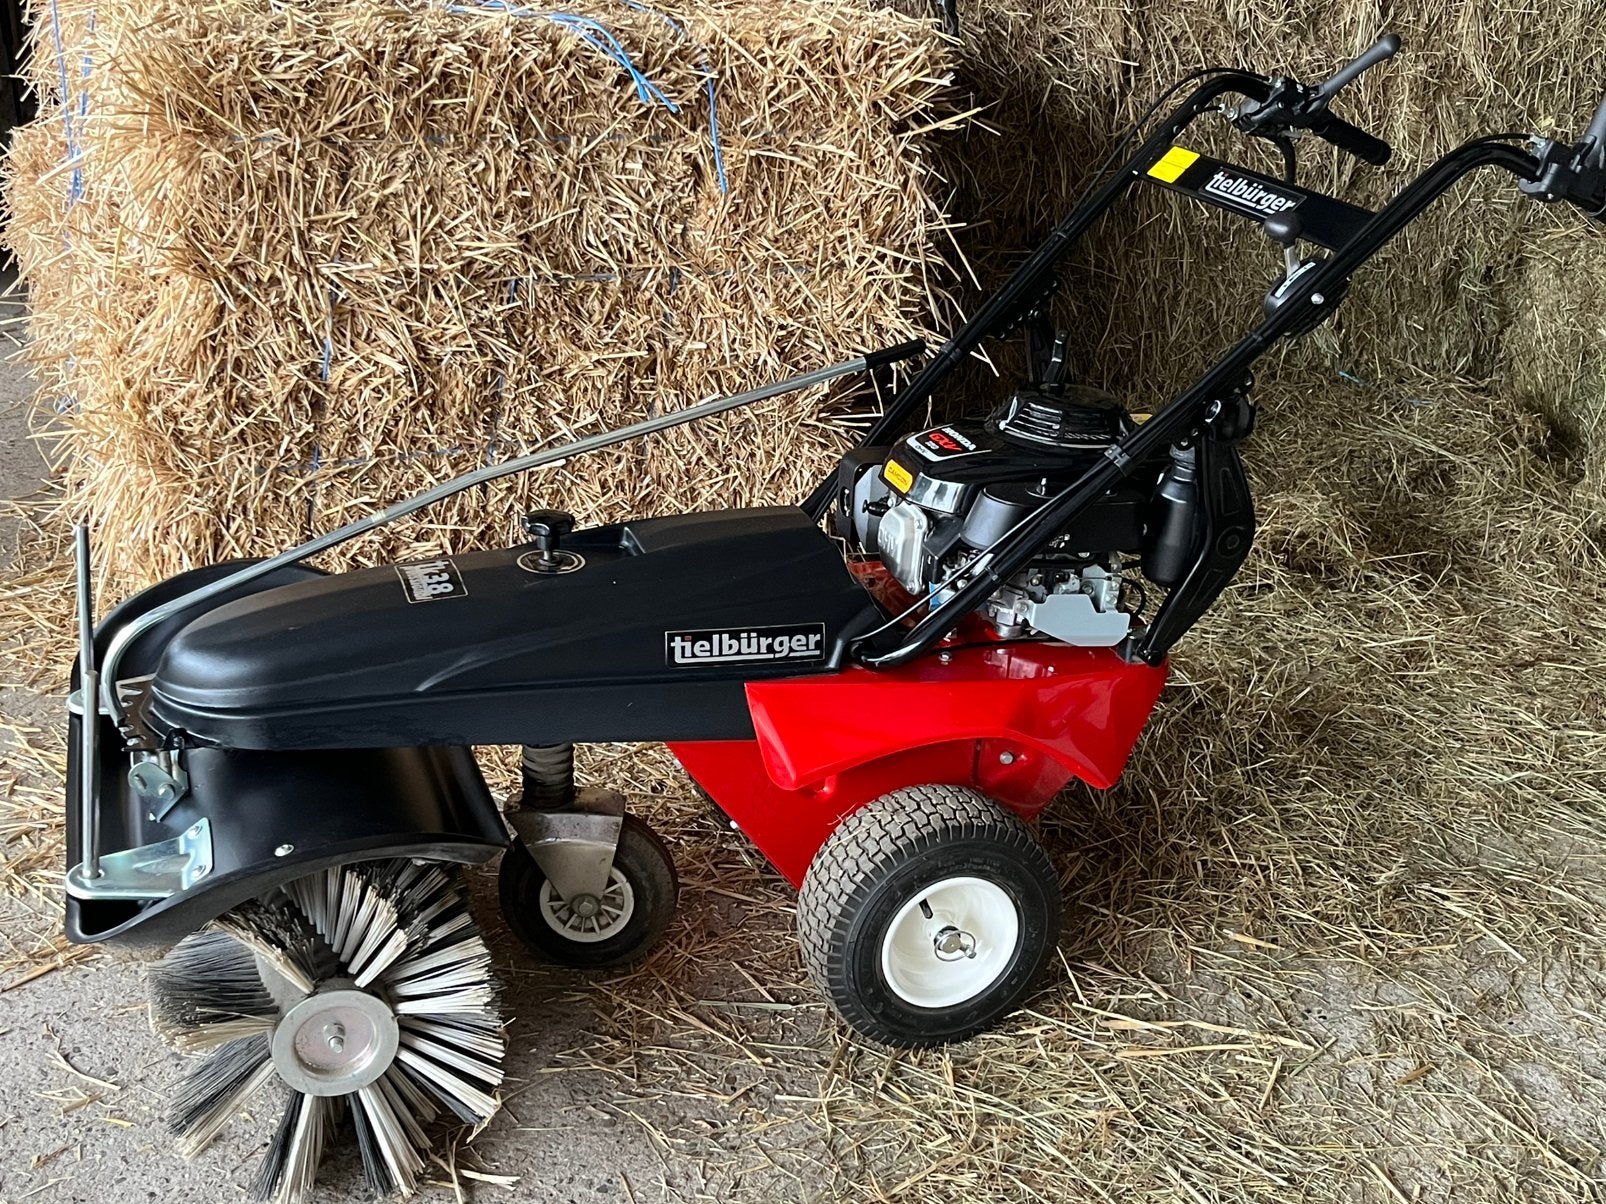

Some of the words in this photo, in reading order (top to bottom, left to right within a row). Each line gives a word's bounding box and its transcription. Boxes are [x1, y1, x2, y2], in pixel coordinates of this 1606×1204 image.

[1205, 171, 1296, 215] tielbürger
[941, 427, 977, 451] HONDA
[671, 633, 821, 663] tielbürger
